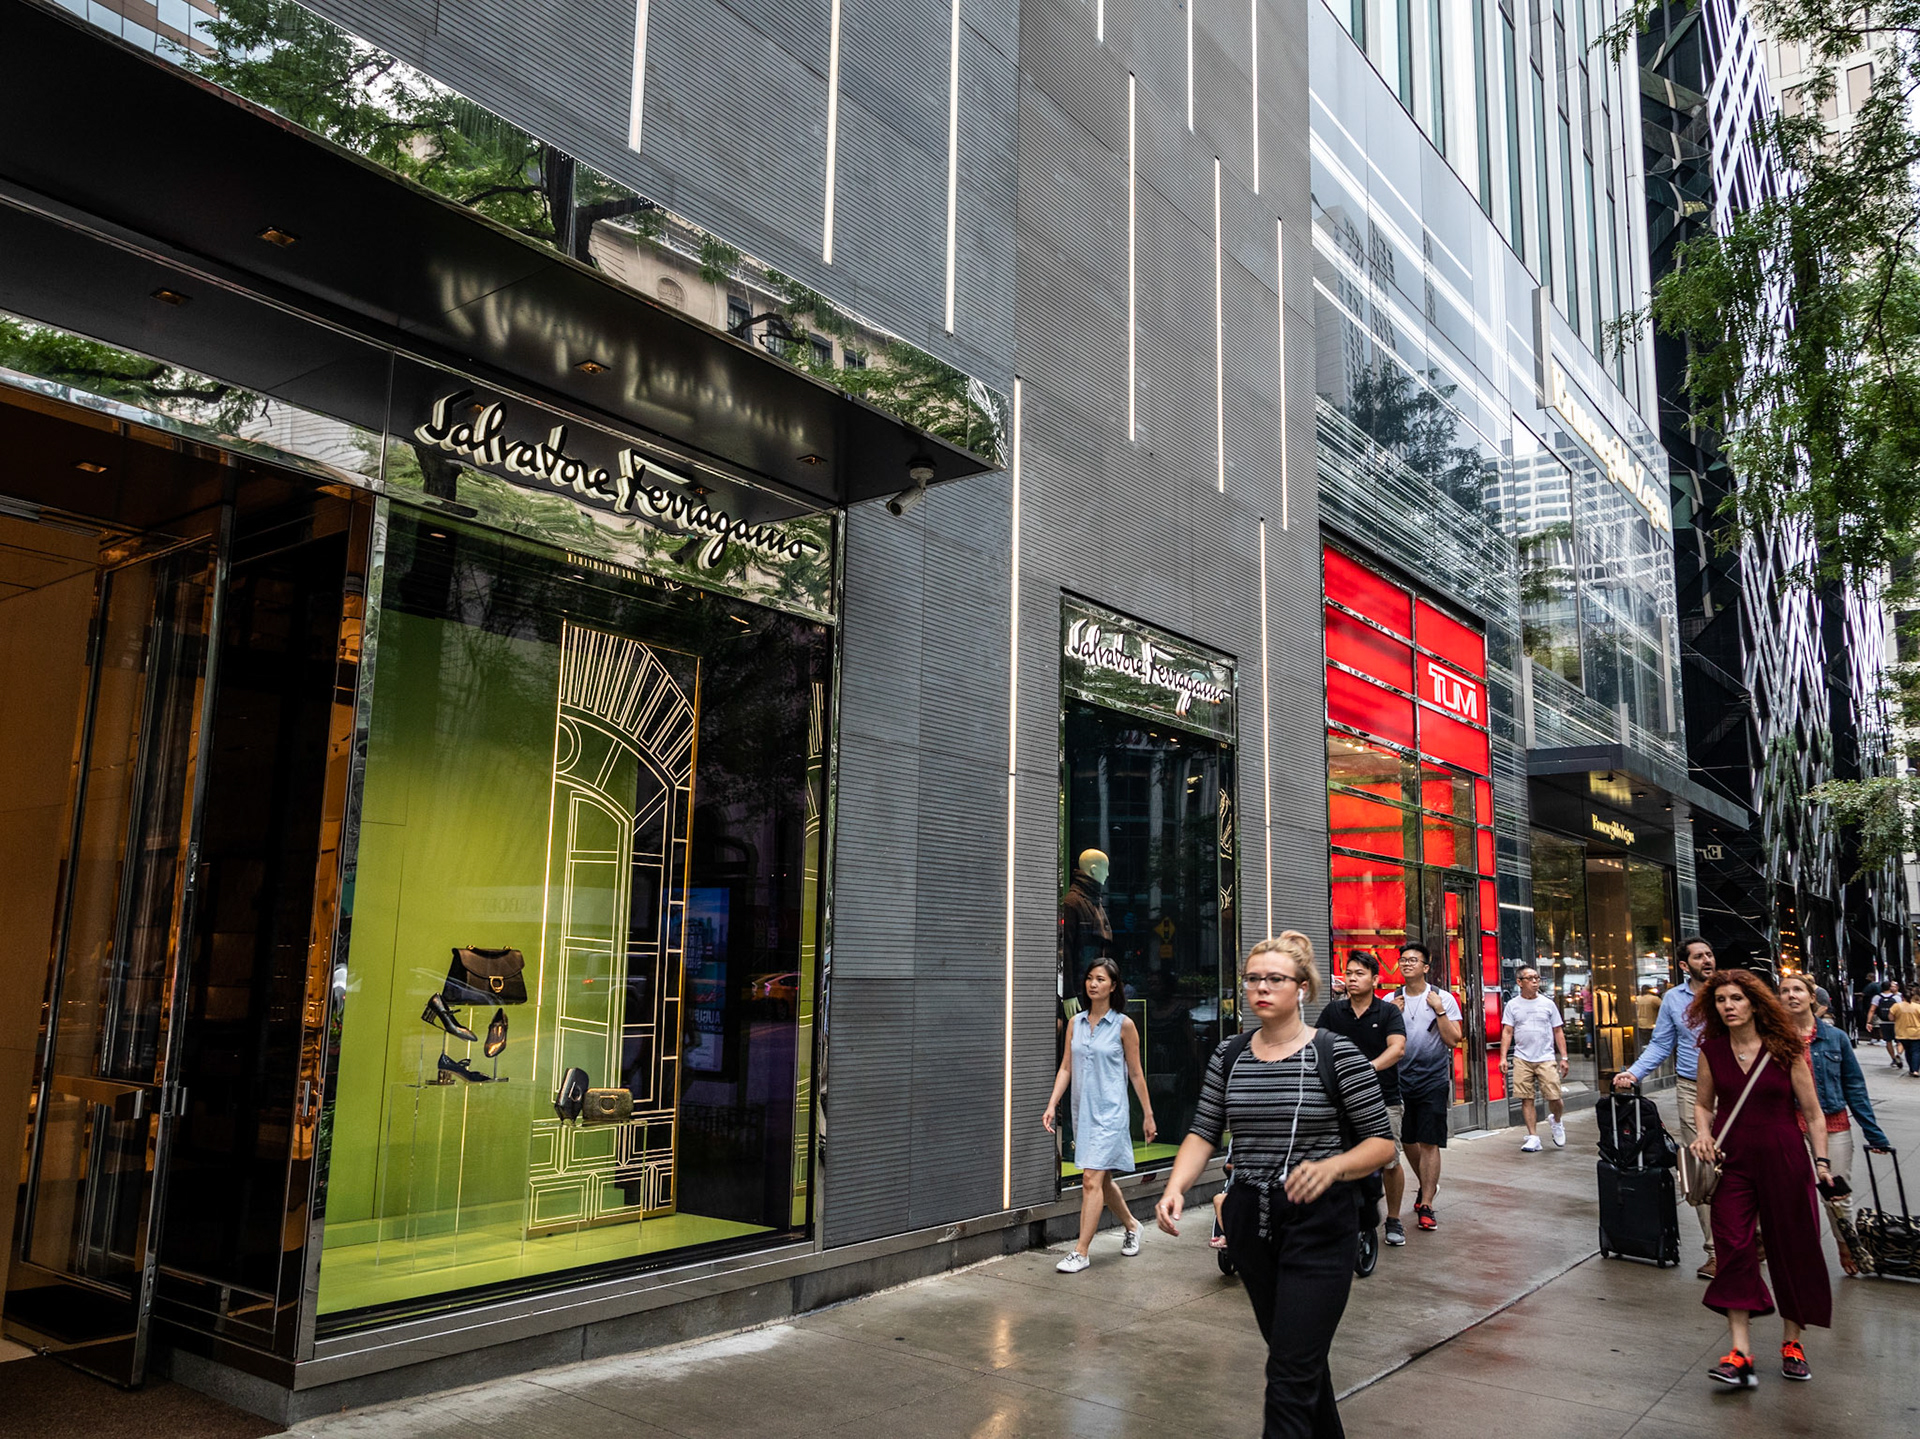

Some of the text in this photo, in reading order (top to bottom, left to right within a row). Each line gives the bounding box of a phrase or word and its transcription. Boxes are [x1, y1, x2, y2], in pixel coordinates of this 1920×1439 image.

[414, 389, 820, 570] Salvatore Ferragamo
[1065, 618, 1233, 716] Salvatore Ferragamo
